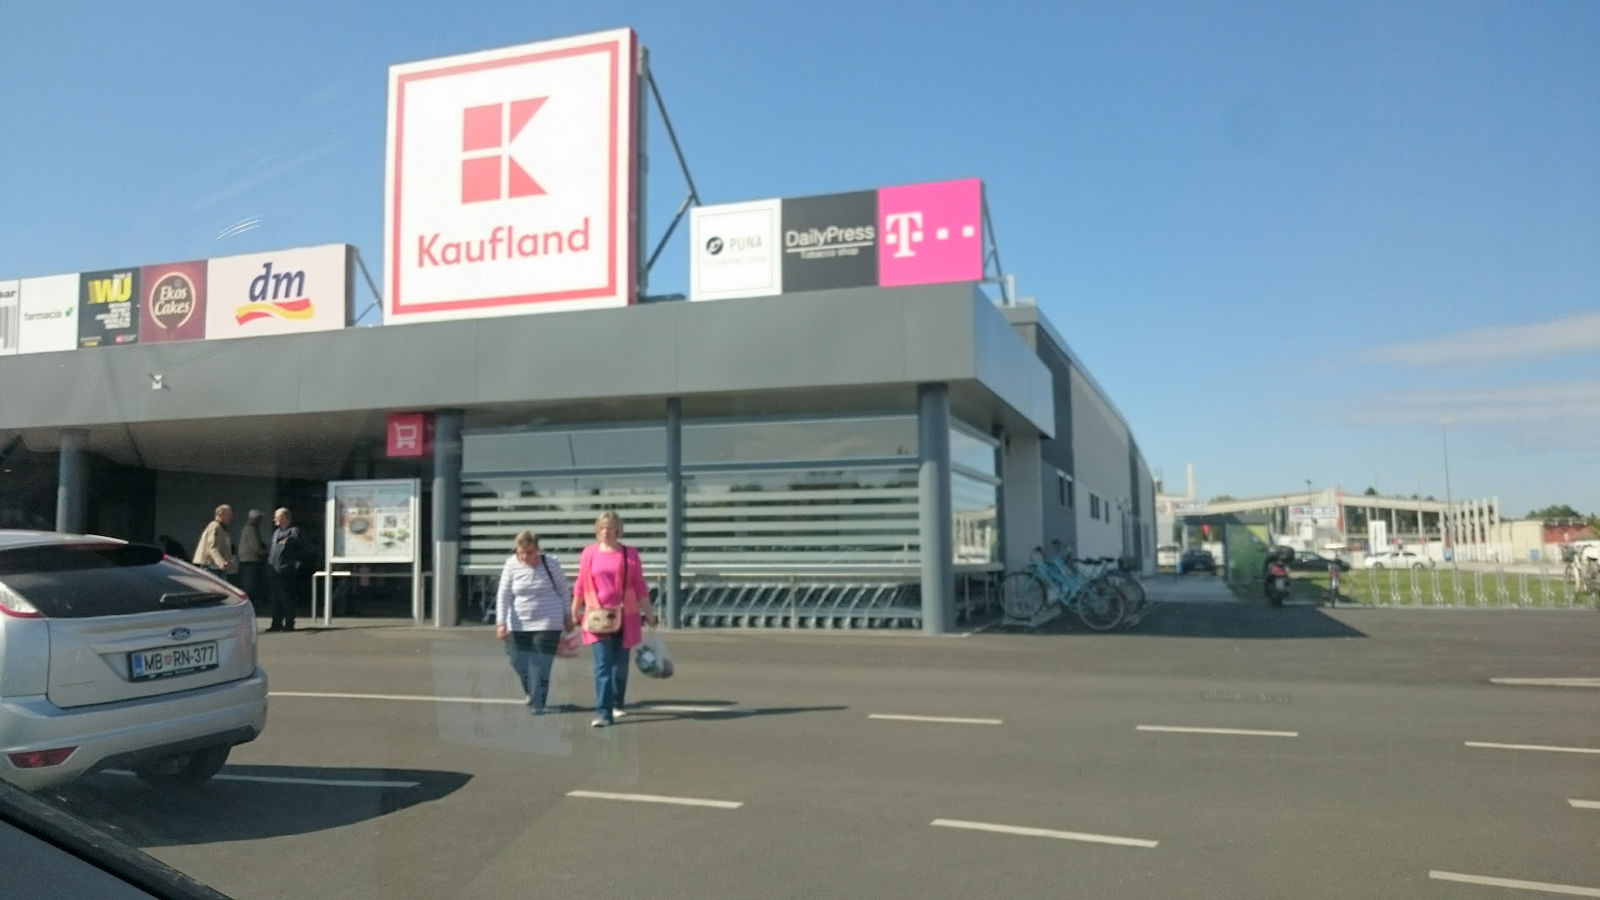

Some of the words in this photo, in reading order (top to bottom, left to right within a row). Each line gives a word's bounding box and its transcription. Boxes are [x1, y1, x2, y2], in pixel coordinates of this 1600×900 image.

[418, 217, 590, 268] Kaufland
[730, 236, 762, 251] PUNA
[785, 225, 876, 247] DailyPress
[88, 274, 132, 304] WU
[160, 285, 187, 300] Ekos
[249, 262, 305, 302] dm
[155, 300, 190, 316] Cakes
[145, 653, 163, 671] MB
[173, 645, 214, 666] RN-377
